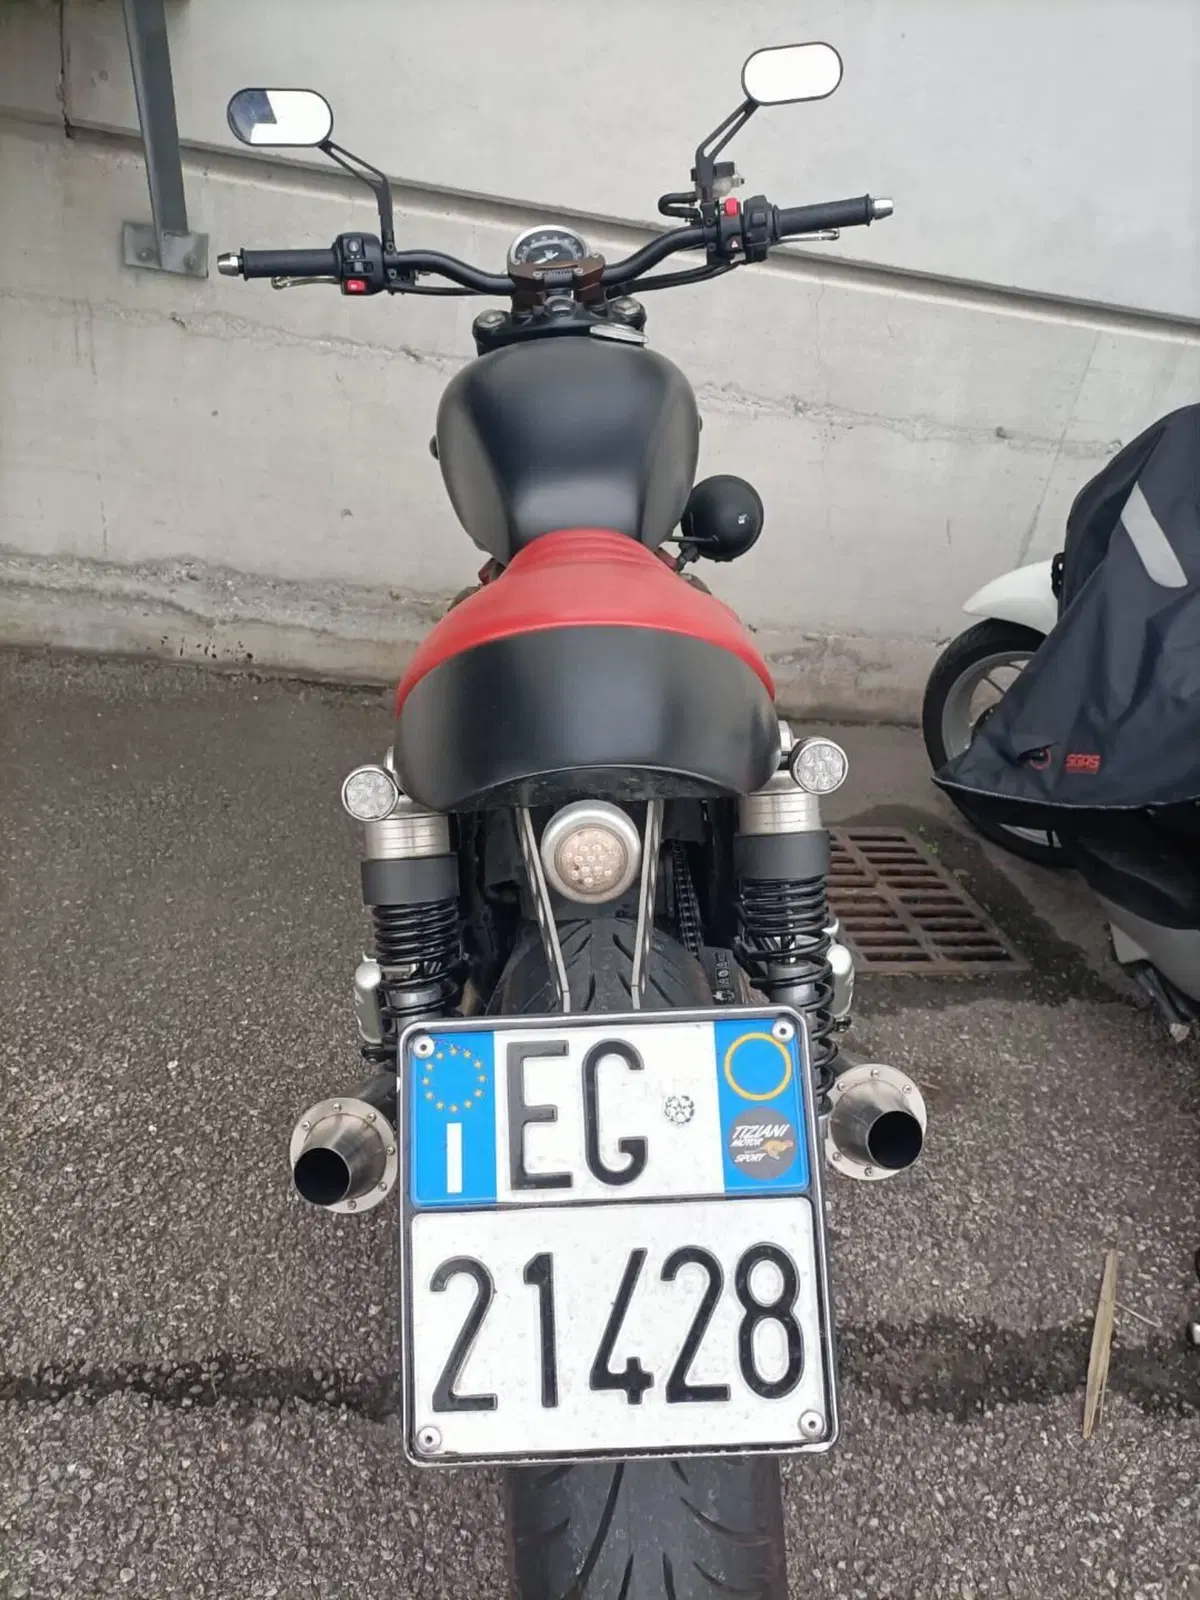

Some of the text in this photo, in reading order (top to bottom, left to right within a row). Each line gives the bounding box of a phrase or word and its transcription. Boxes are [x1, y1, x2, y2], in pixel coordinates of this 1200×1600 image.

[506, 1037, 649, 1191] EG
[732, 1123, 790, 1140] TIZIANI
[730, 1137, 764, 1148] MOTOR
[733, 1152, 768, 1164] SPORT
[429, 1241, 806, 1413] 21428
